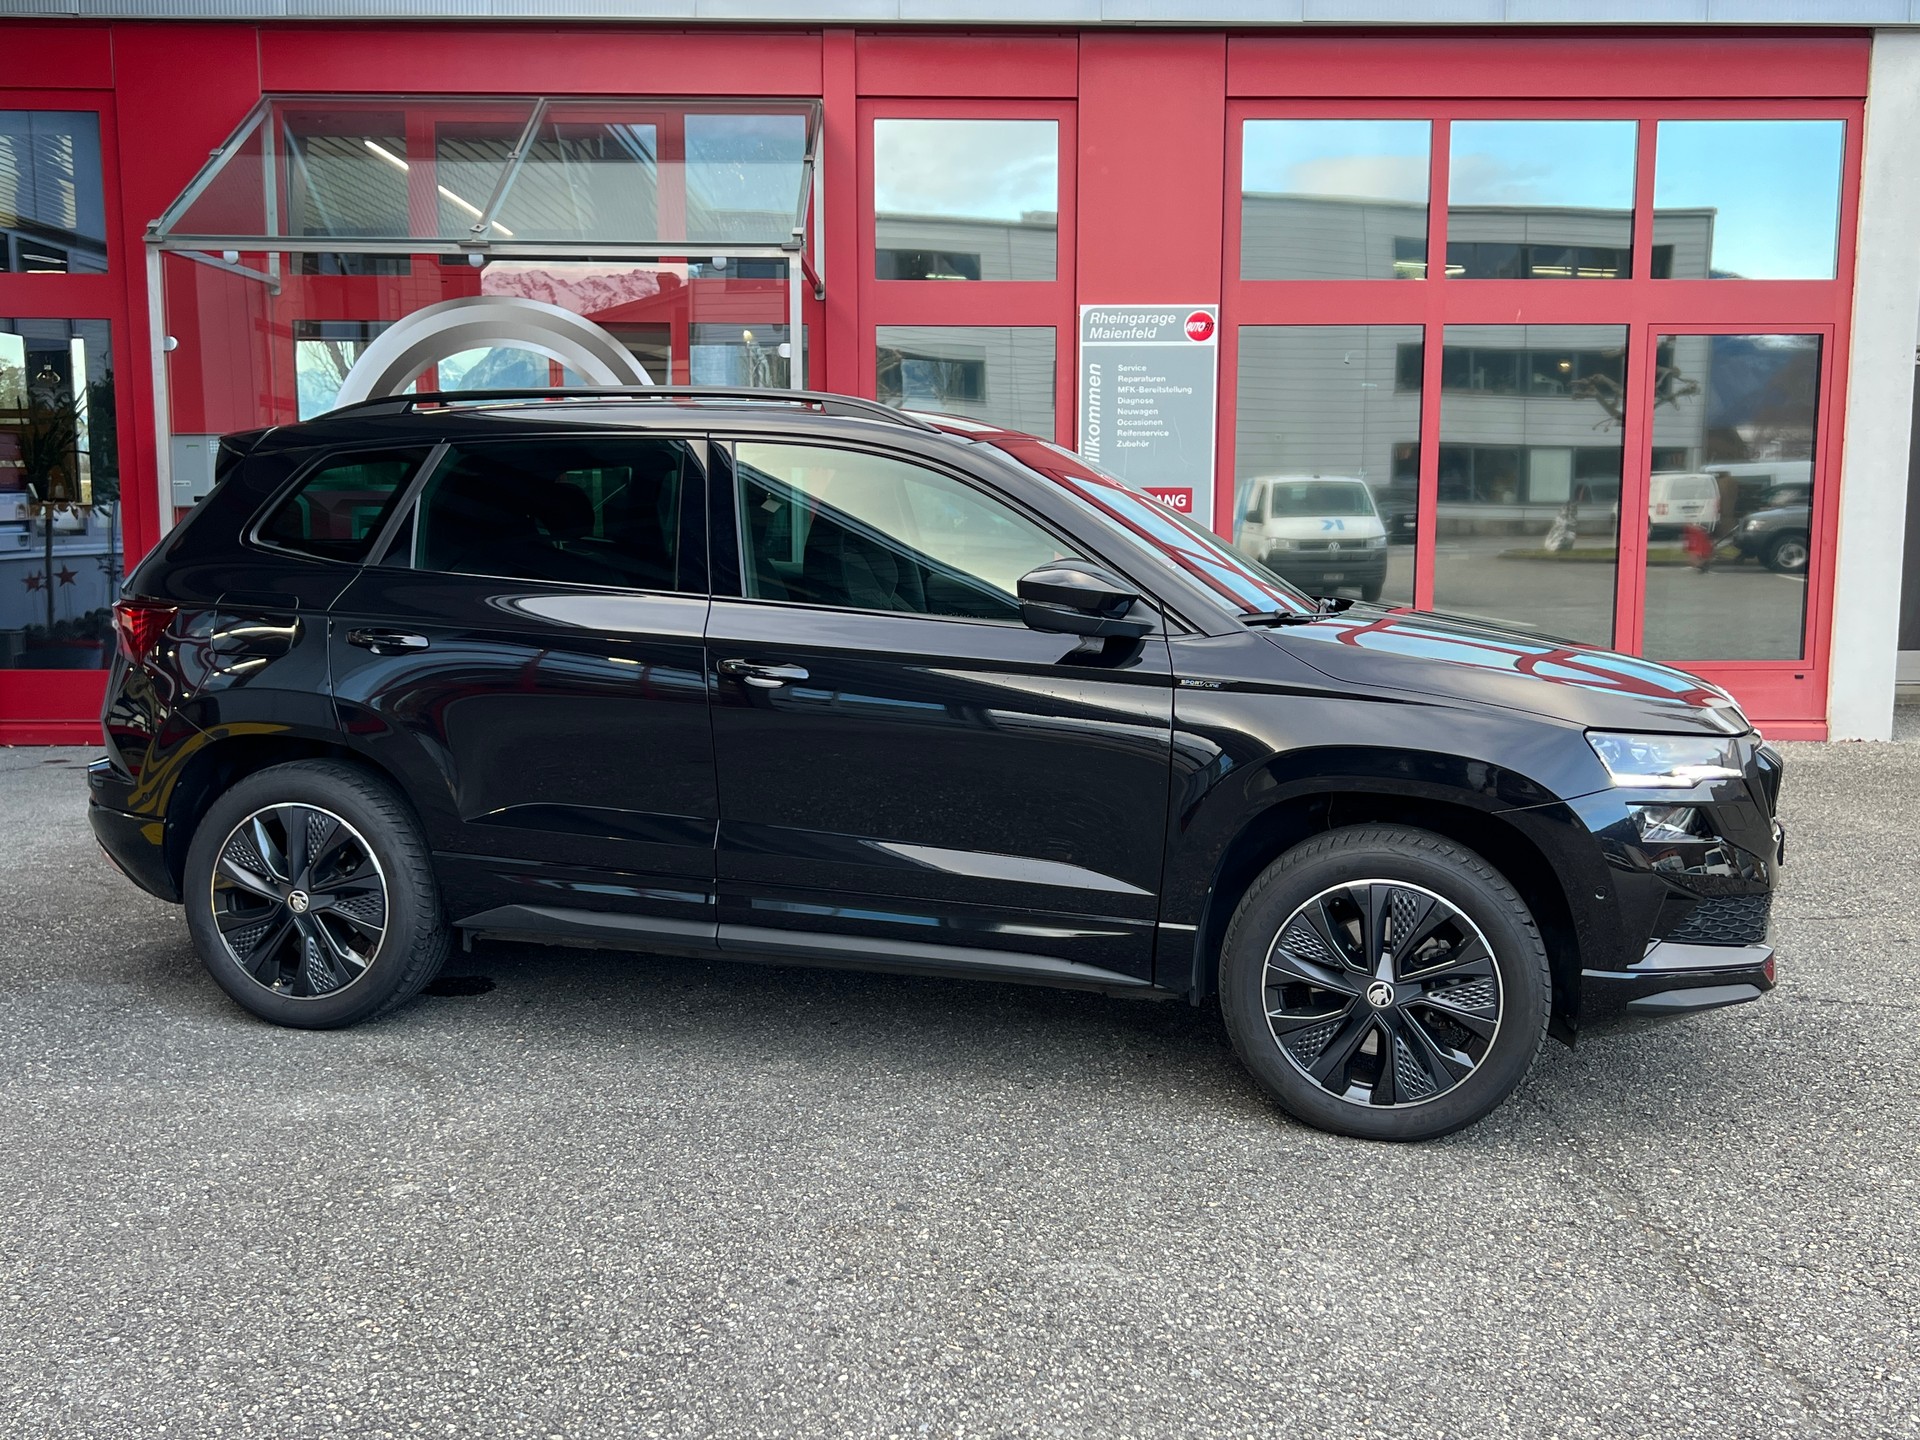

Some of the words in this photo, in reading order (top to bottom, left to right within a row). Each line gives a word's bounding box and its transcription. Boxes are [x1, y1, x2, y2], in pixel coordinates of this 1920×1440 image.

[1089, 312, 1177, 326] Rheingarage
[1089, 327, 1157, 339] Maienfeld
[1118, 364, 1147, 372] Service
[1118, 375, 1166, 383] Reparaturen
[1117, 386, 1193, 394] MFK-Bereitstellung
[1117, 397, 1154, 405] Diagnose
[1084, 363, 1101, 463] illkommen
[1117, 408, 1159, 416] Neuwagen
[1117, 418, 1163, 426] Occasionen
[1117, 429, 1170, 437] Reifenservice
[1116, 440, 1150, 448] Zubehör
